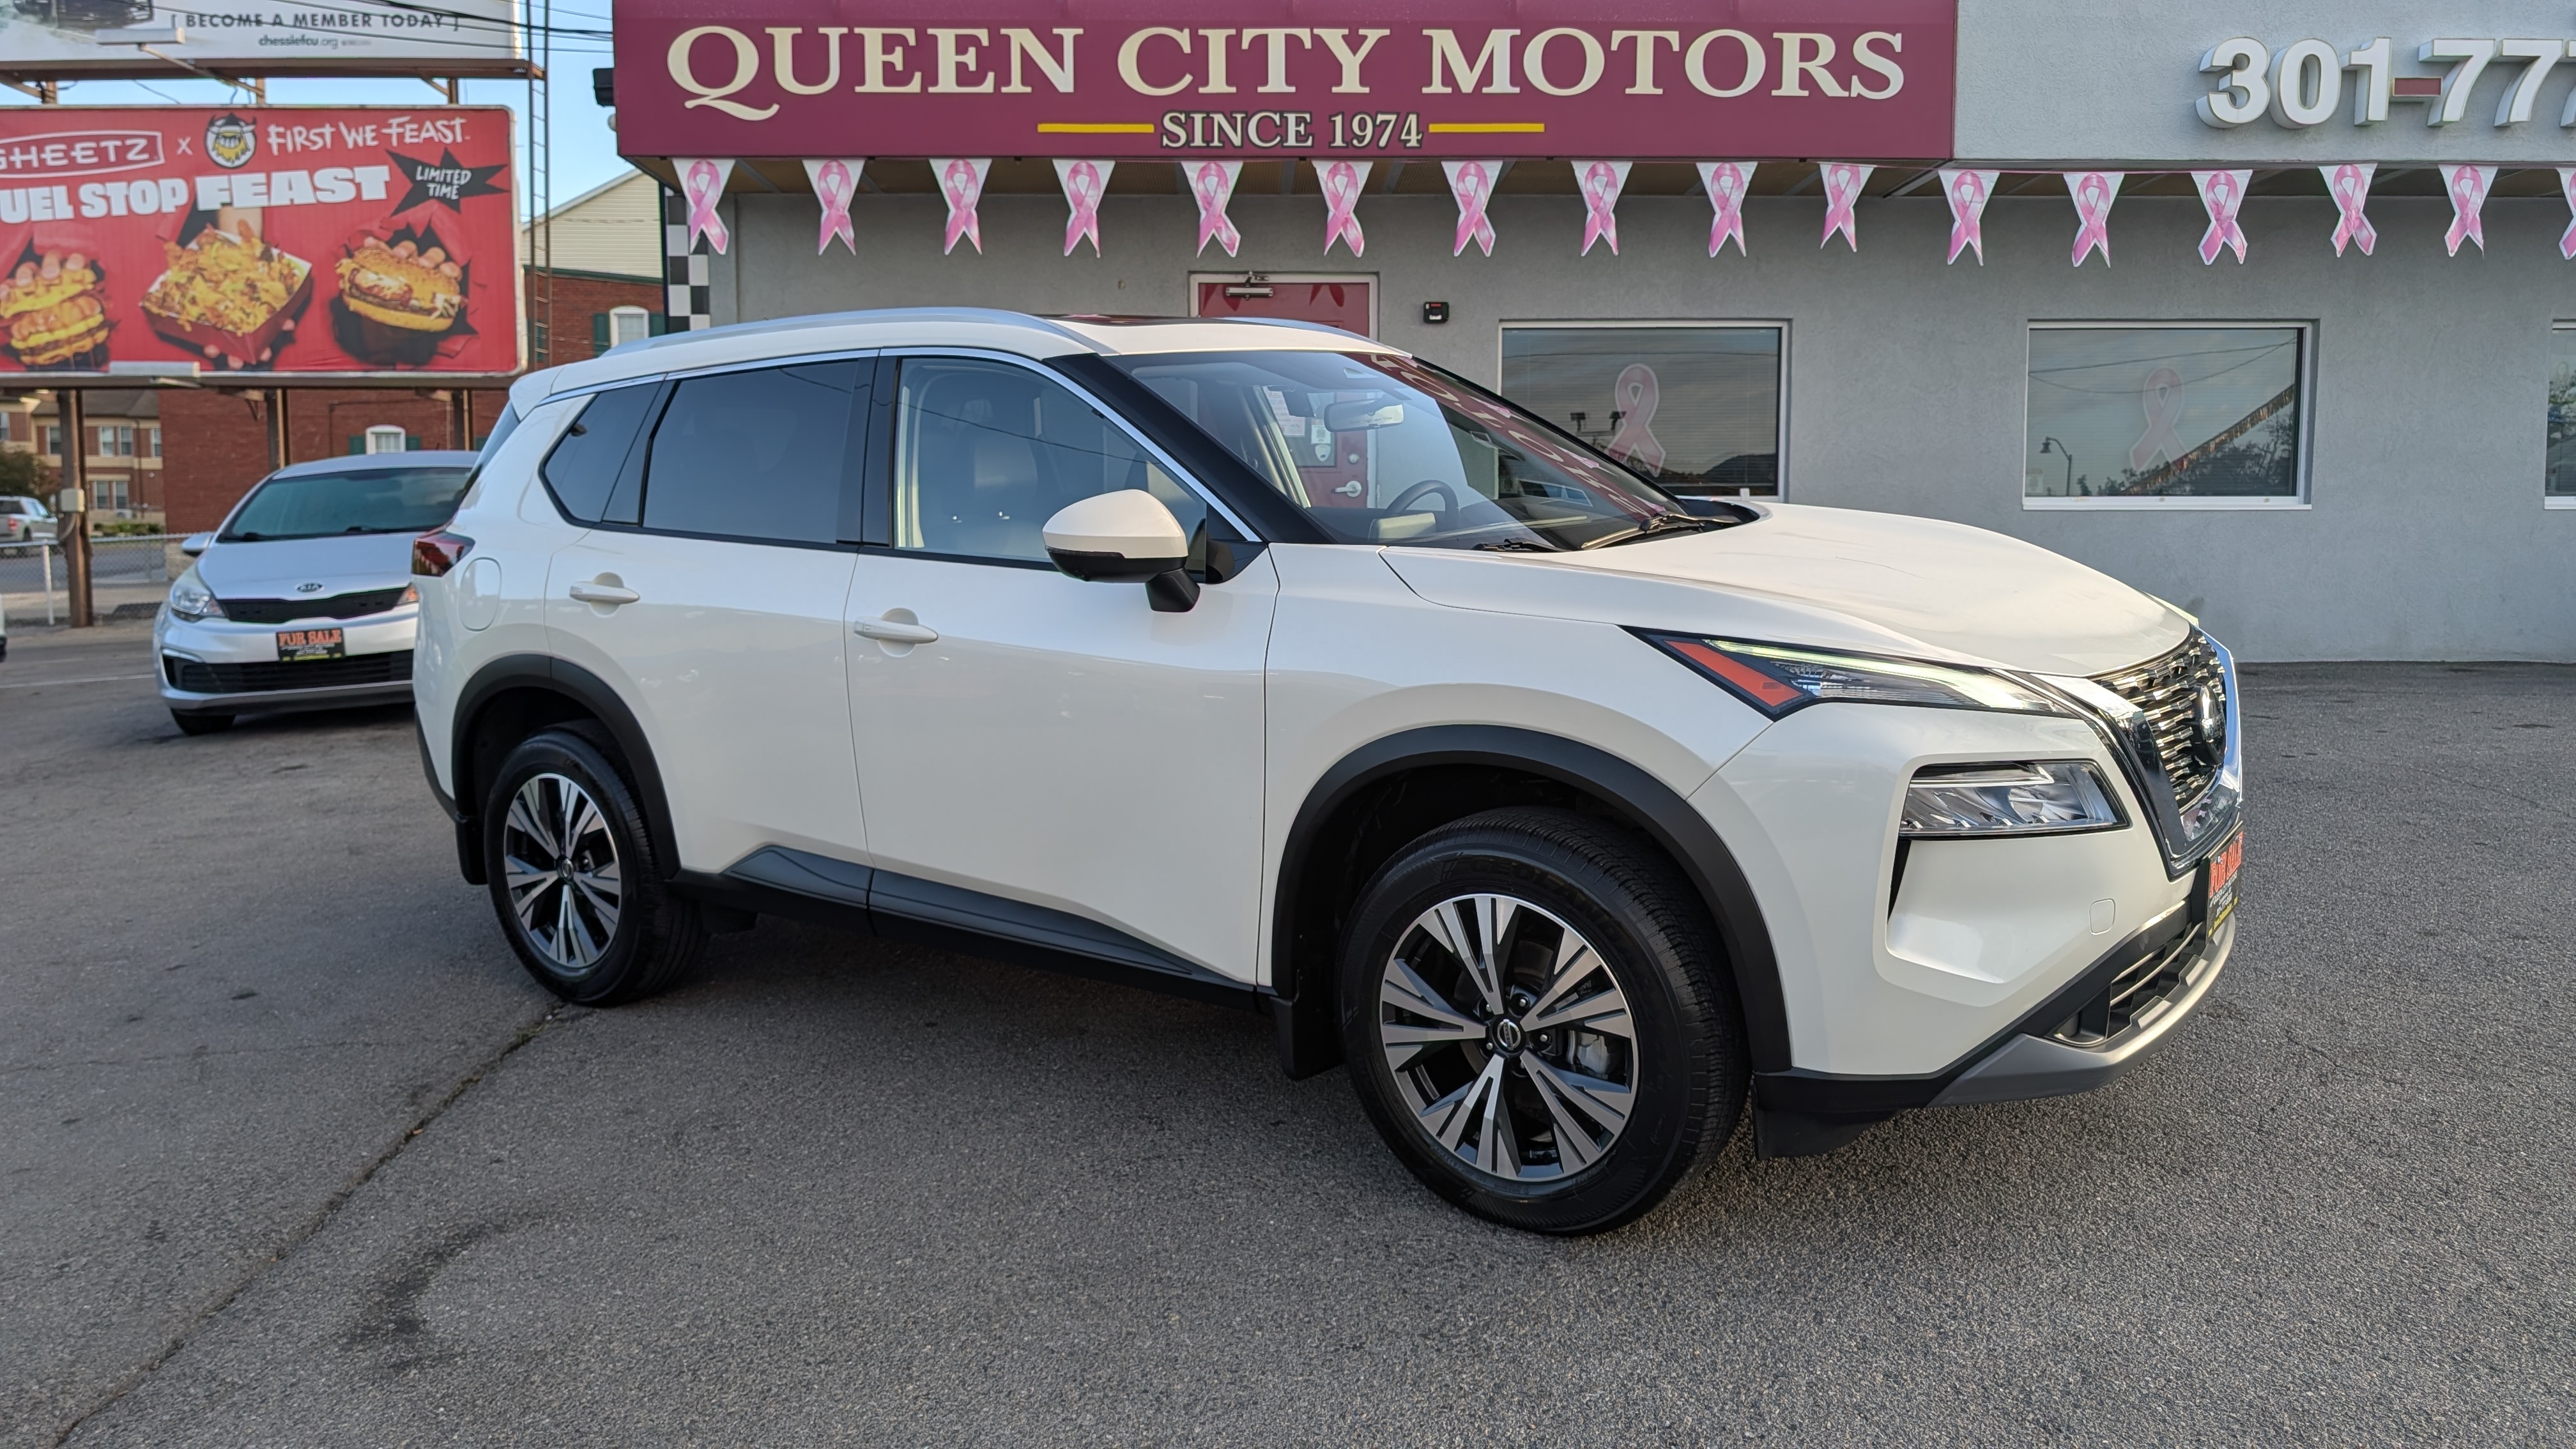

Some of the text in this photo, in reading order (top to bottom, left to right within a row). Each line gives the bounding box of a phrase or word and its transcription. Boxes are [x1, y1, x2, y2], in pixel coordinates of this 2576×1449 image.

[186, 13, 263, 27] BECOME
[271, 14, 284, 27] A
[293, 13, 372, 27] MEMBER
[383, 13, 445, 27] TODAY
[666, 25, 1906, 121] QUEEN CITY MOTORS
[2196, 36, 2576, 126] 301-77
[266, 122, 337, 157] FIRST
[338, 120, 379, 150] WE
[381, 115, 467, 147] FEAST
[1161, 110, 1424, 150] SINCE 1974
[77, 178, 190, 218] STOP
[194, 164, 391, 211] FEAST
[415, 164, 472, 185] LIMITED
[426, 183, 460, 200] TIME
[278, 632, 307, 647] FOR
[307, 629, 342, 645] SALE
[2209, 851, 2227, 899] FOR
[2226, 831, 2244, 880] SALE
